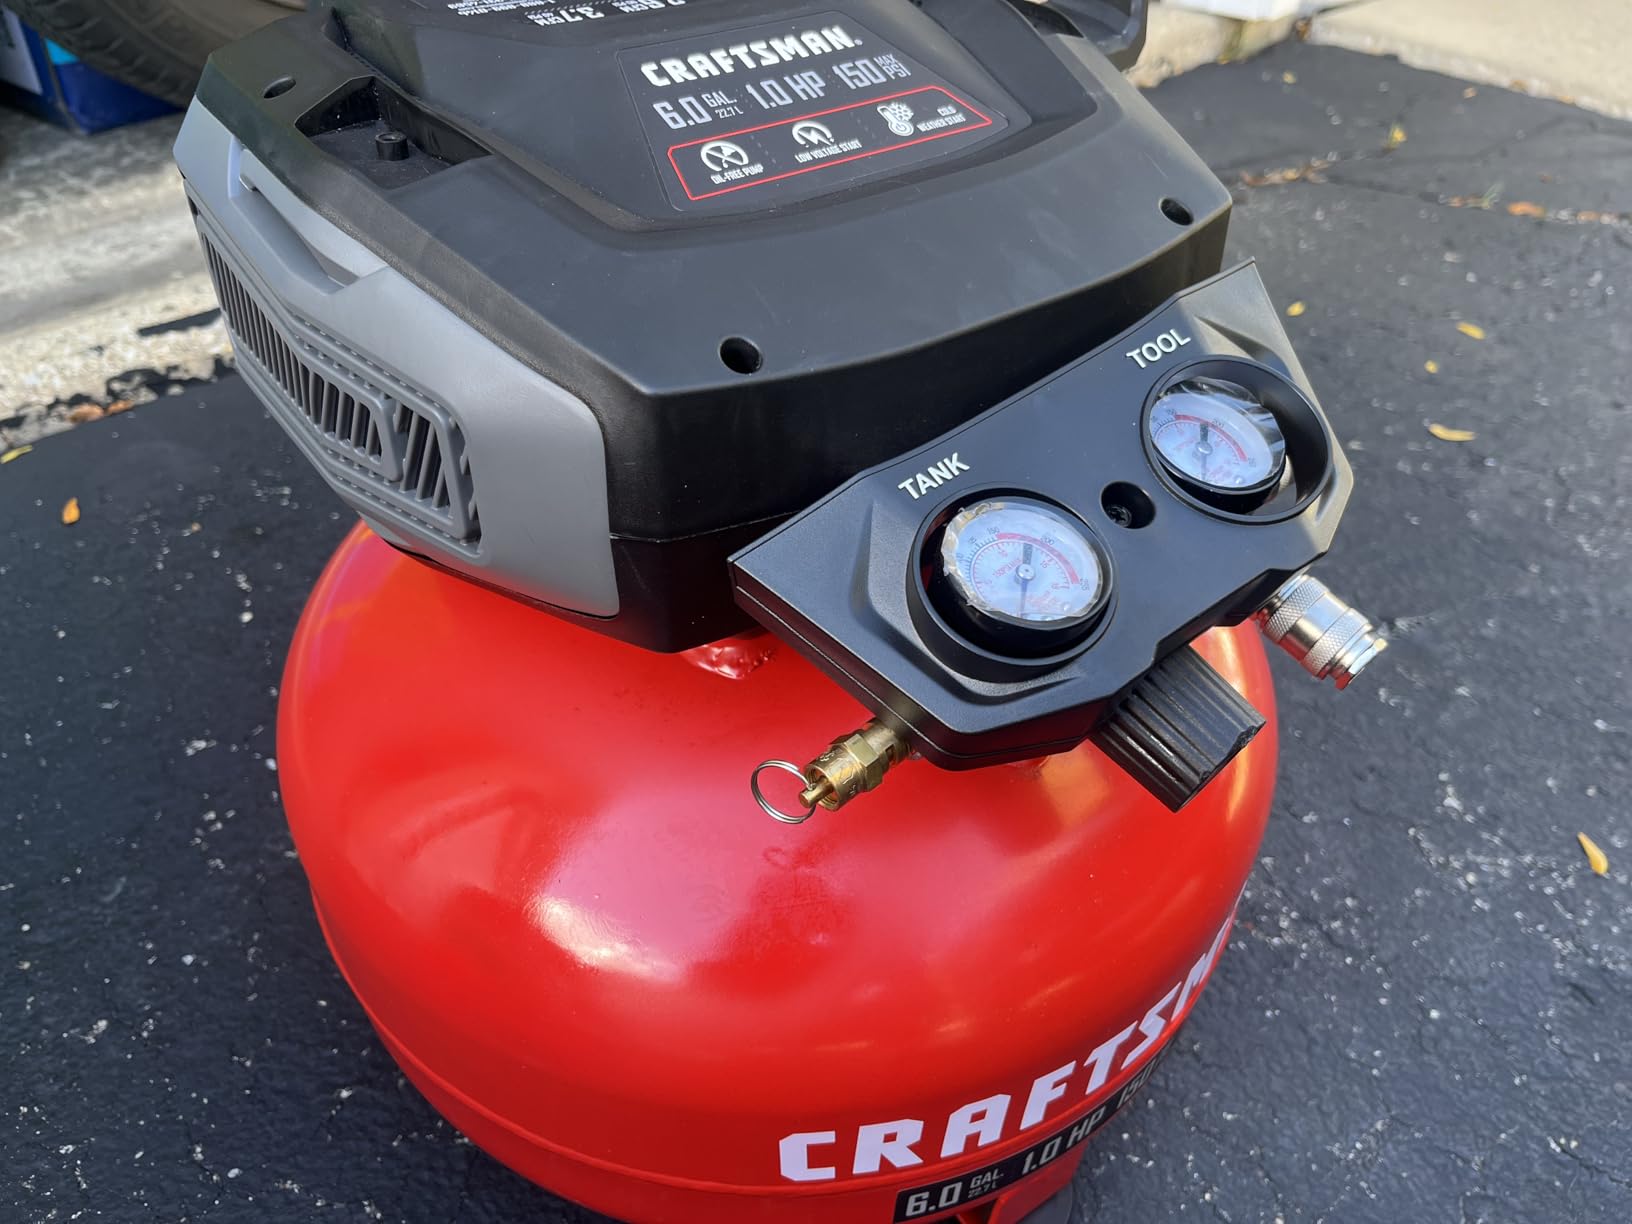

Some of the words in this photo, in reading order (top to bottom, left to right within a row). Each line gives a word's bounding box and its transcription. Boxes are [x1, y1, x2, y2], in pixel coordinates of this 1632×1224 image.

[743, 80, 787, 111] 1.0
[781, 69, 827, 102] HP
[832, 58, 884, 91] 150
[875, 53, 899, 69] MAX
[883, 64, 912, 82] PSI
[653, 95, 713, 130] 6.0
[704, 88, 738, 108] GAL.
[916, 117, 948, 133] WEATHER
[944, 113, 967, 126] START
[794, 152, 813, 164] LOW
[810, 145, 842, 160] VOLTAGE
[838, 139, 863, 152] START
[710, 168, 745, 185] OIL-FREE
[742, 163, 764, 177] PUMP
[1126, 328, 1191, 370] TOOL
[898, 453, 970, 500] TANK
[1021, 1136, 1060, 1175] 1.0
[1066, 1105, 1106, 1149] HP
[905, 1181, 962, 1218] 6.0
[969, 1168, 1004, 1188] GAL.
